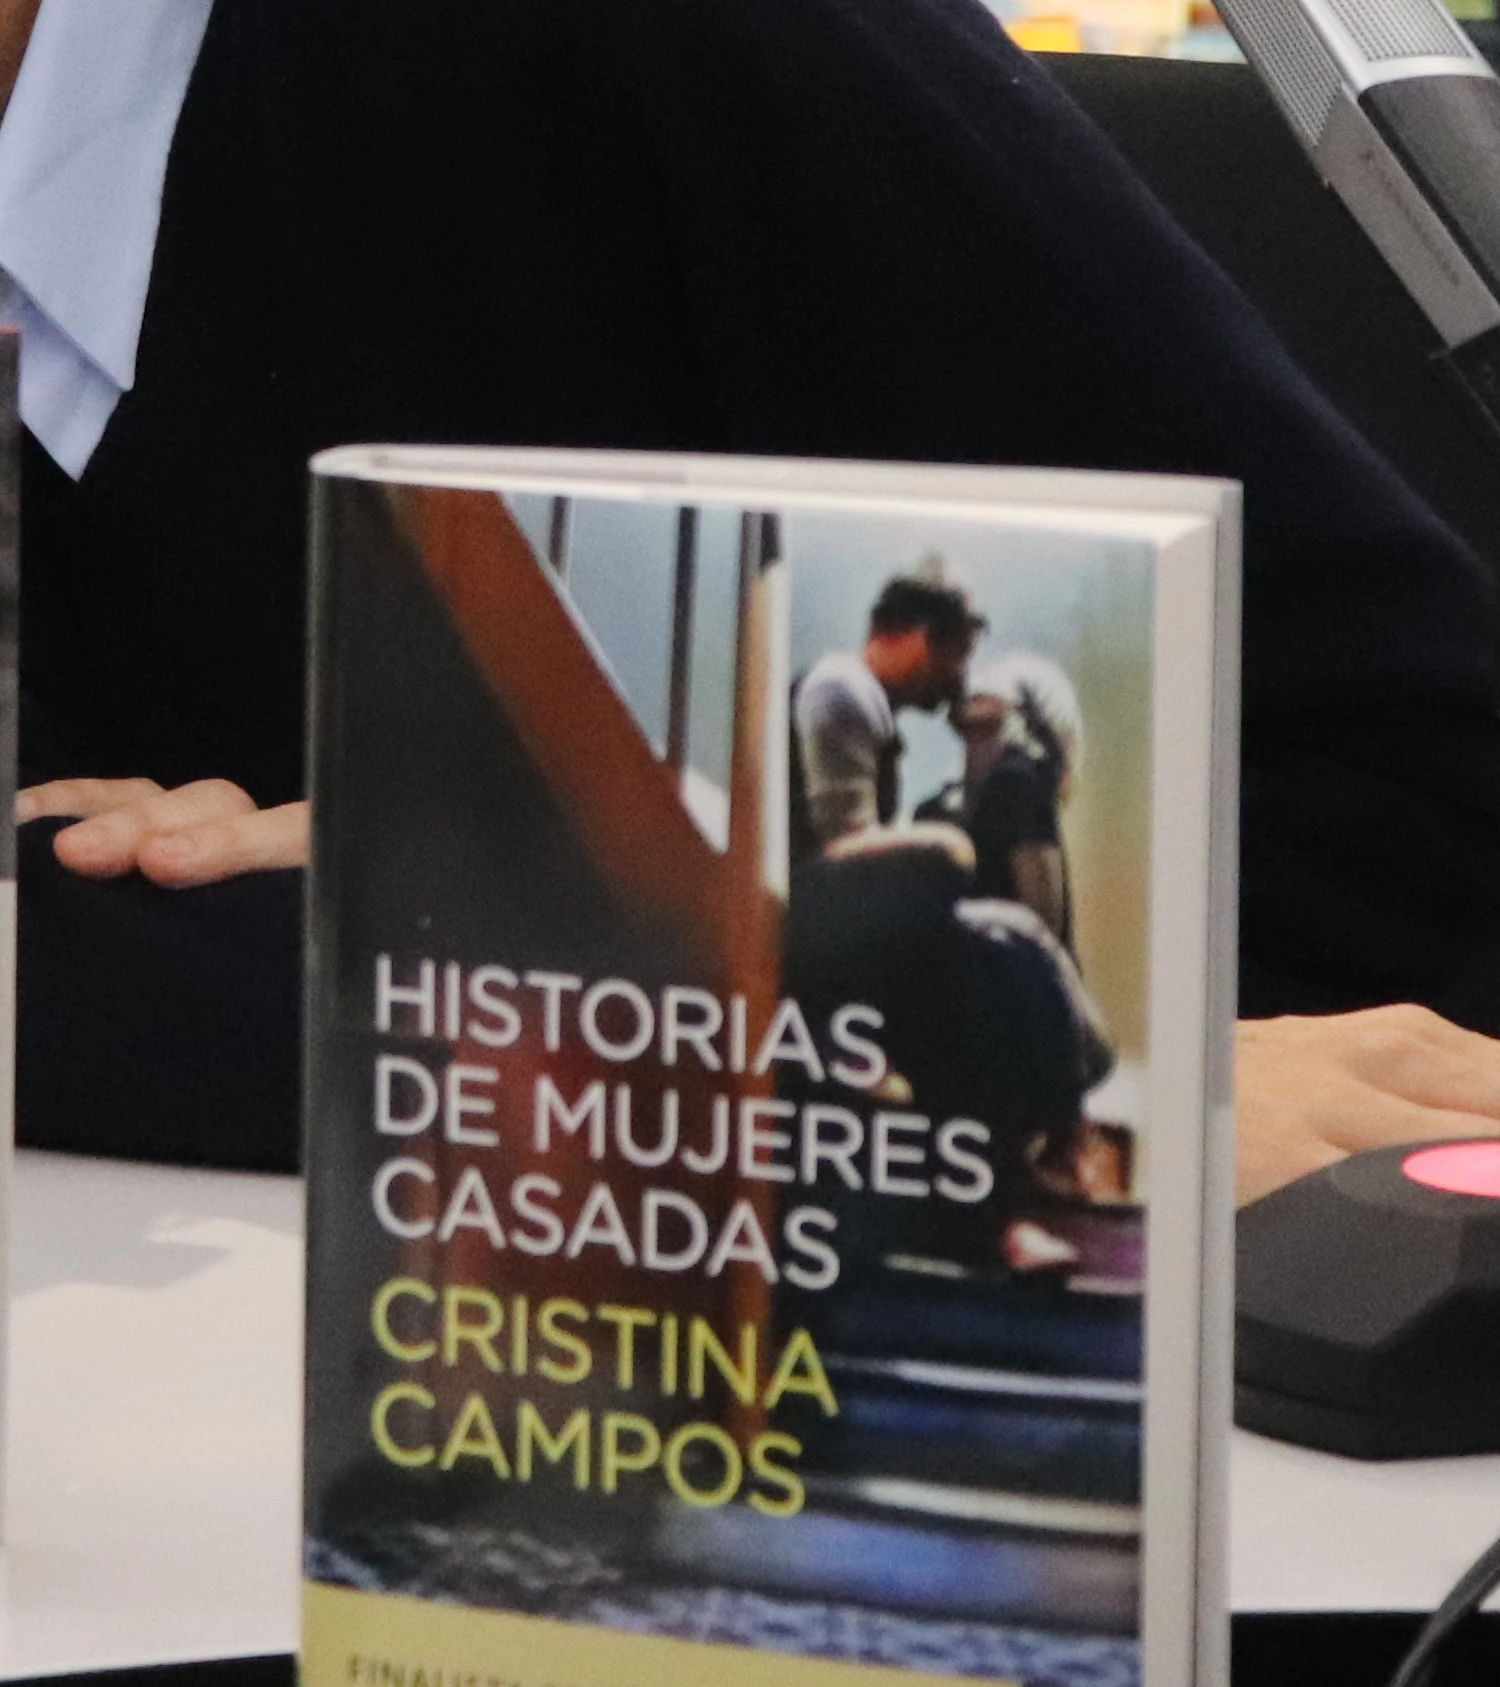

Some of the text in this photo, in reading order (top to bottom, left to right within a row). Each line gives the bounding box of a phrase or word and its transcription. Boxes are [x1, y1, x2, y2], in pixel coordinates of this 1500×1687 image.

[374, 952, 888, 1089] HISTORIAS
[374, 1055, 995, 1205] DE MUJERES
[371, 1158, 841, 1291] CASADAS
[371, 1277, 840, 1417] CRISTINA
[370, 1384, 806, 1517] CAMPOS
